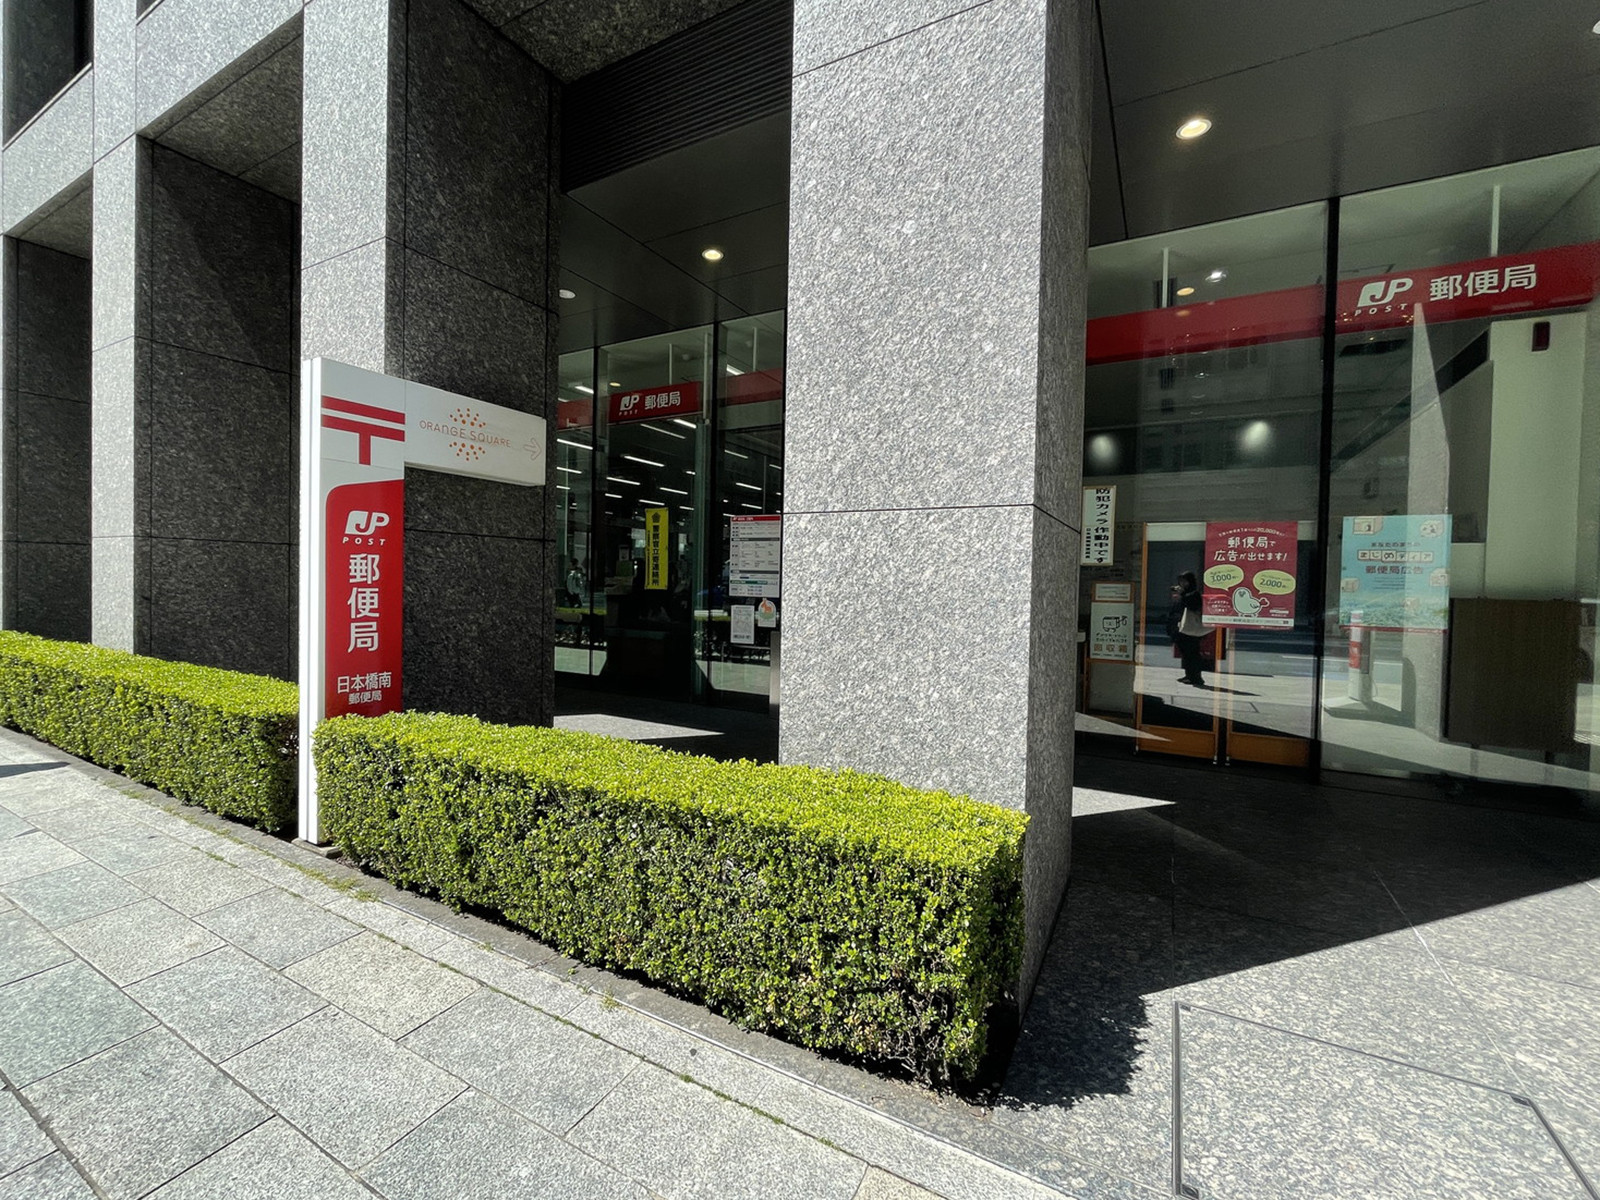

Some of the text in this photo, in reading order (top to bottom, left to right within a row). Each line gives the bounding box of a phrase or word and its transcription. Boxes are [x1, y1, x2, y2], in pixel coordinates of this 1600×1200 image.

[1430, 263, 1536, 301] 郵便局
[1357, 278, 1413, 308] JP
[1354, 303, 1408, 316] POST
[644, 391, 681, 410] 郵便局
[470, 430, 511, 448] SQUARE
[344, 510, 390, 535] JP
[342, 537, 386, 546] POST
[1227, 536, 1276, 549] 郵便局で
[347, 553, 380, 653] 郵便局
[337, 671, 392, 694] 日本橋南
[348, 690, 382, 705] 郵便局
